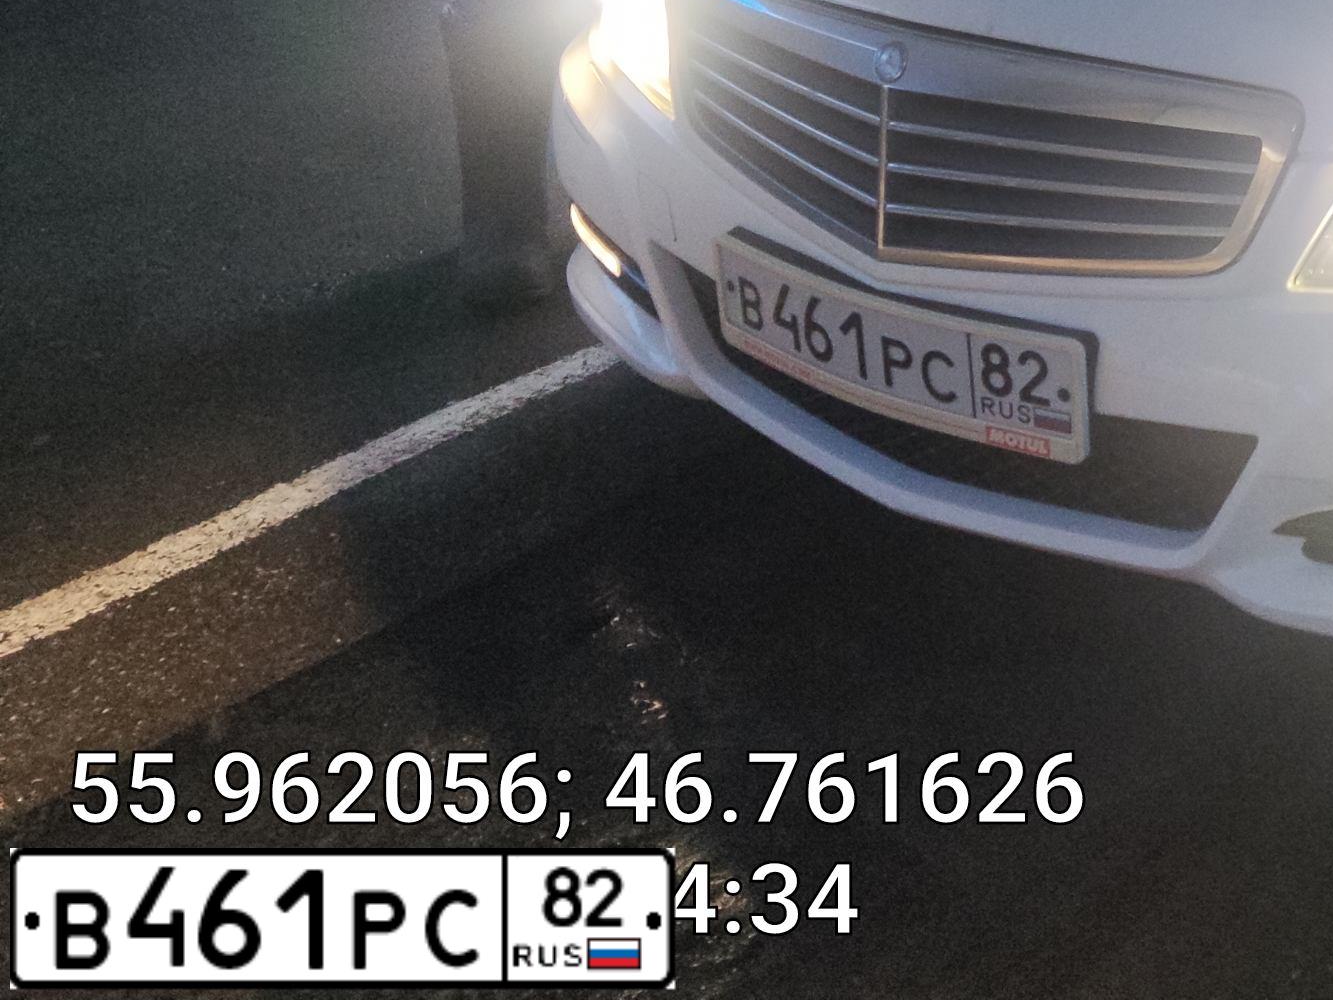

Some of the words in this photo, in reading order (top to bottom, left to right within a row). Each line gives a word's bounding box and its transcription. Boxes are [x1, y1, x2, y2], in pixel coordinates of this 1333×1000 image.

[980, 342, 1052, 408] 82
[980, 396, 1032, 424] RUS
[989, 429, 1050, 455] MOTUL
